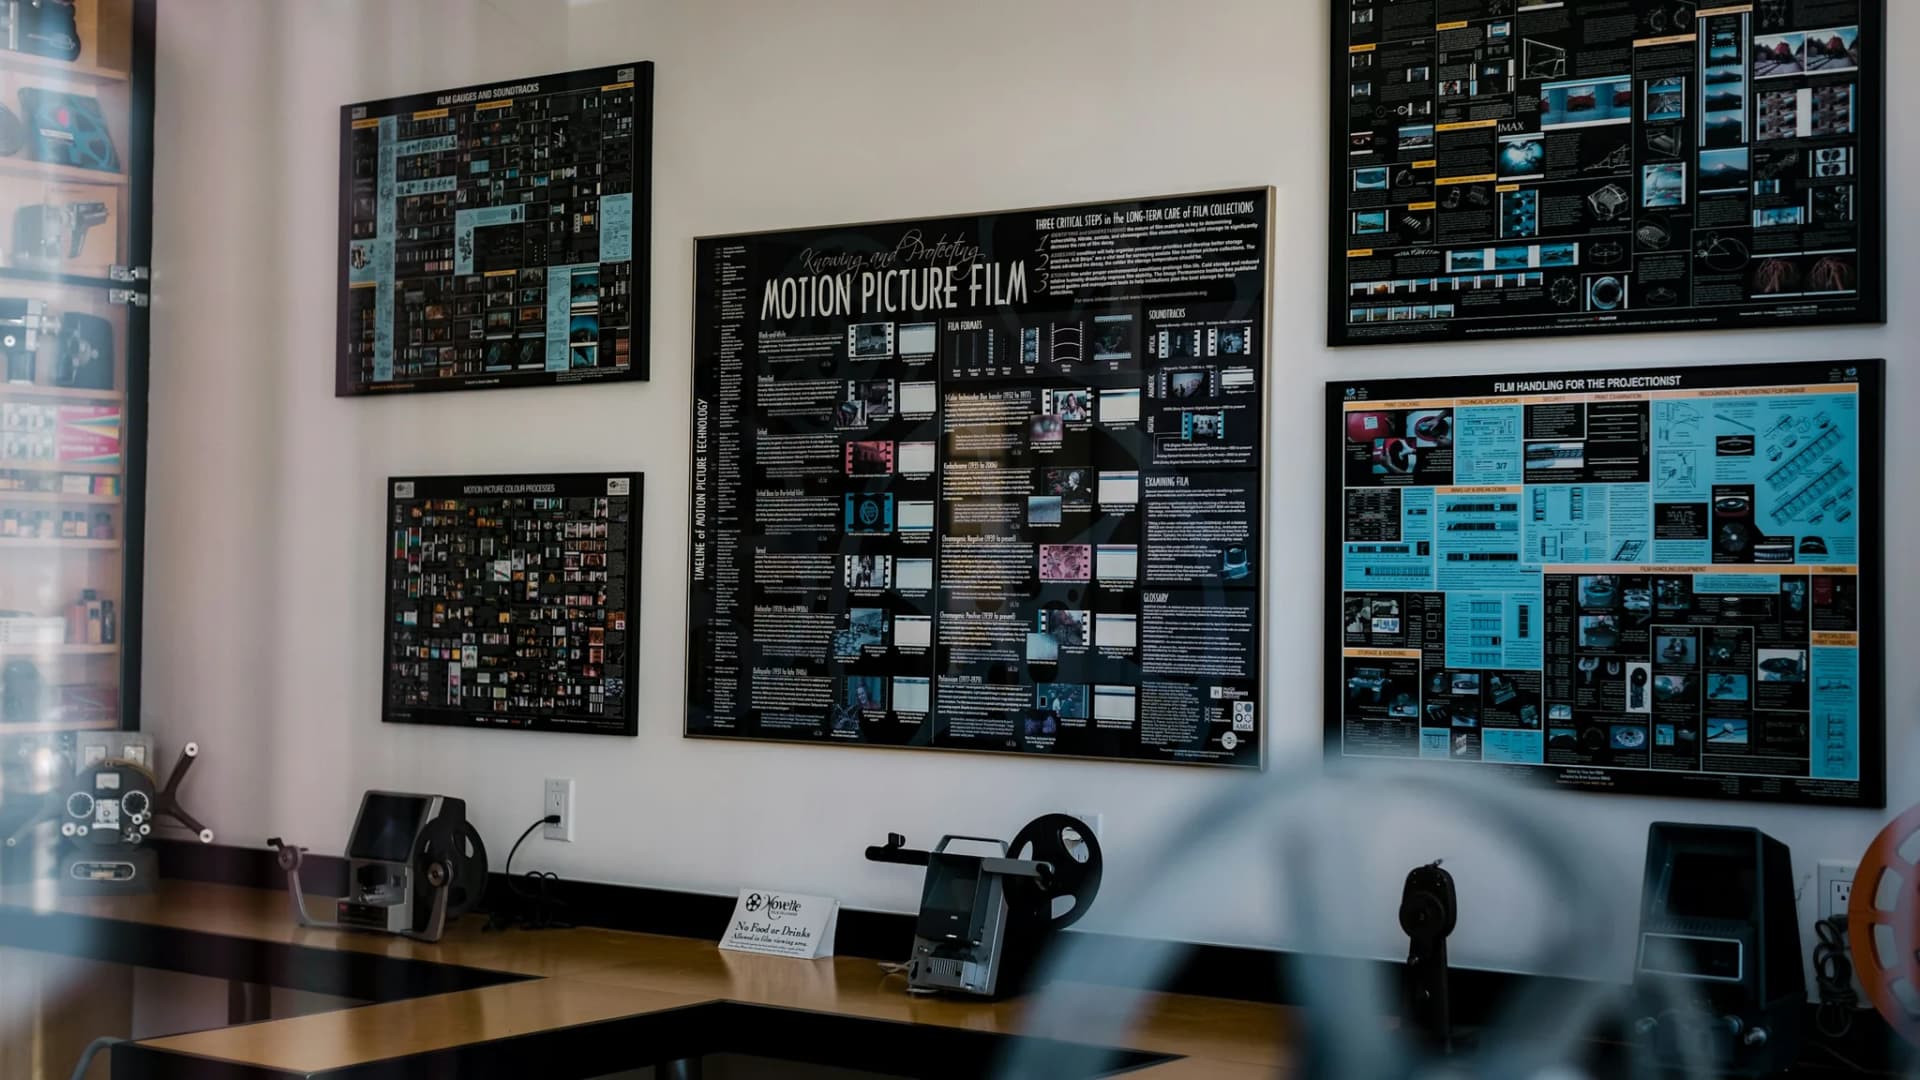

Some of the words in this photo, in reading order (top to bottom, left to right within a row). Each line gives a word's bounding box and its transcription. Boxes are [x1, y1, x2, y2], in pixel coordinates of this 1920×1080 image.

[437, 96, 452, 105] FILM
[452, 92, 477, 104] GAUGES
[478, 90, 492, 100] AND
[493, 83, 539, 98] SOUNDTRACKS
[1498, 121, 1524, 132] IMAX
[1036, 216, 1054, 229] THREE
[1056, 214, 1082, 227] CRITICAL
[1084, 213, 1102, 225] STEPS
[1104, 213, 1110, 224] in
[1113, 211, 1124, 223] the
[1126, 208, 1162, 222] LONG-TERM
[1164, 207, 1180, 219] CARE
[1192, 205, 1208, 217] FILM
[1210, 201, 1254, 216] COLLECTIONS
[802, 248, 869, 284] Knowing
[869, 248, 899, 270] and
[896, 228, 986, 281] Protecting
[1034, 254, 1048, 271] 2
[761, 273, 850, 321] MOTION
[862, 265, 958, 314] PICTURE
[969, 259, 1028, 307] FILM
[1033, 272, 1048, 293] 3
[1148, 308, 1186, 320] SOUNDTRACKS
[948, 322, 959, 331] FILM
[960, 320, 982, 330] FORMATS
[1494, 382, 1515, 393] FILM
[1516, 380, 1564, 392] HANDLING
[1566, 379, 1584, 390] FOR
[1587, 378, 1605, 389] THE
[1608, 376, 1681, 388] PROJECTIONIST
[696, 398, 708, 453] TECHNOLOGY
[696, 456, 707, 491] PICTURE
[1496, 462, 1508, 470] 3/7
[464, 484, 482, 494] MOTION
[484, 484, 504, 494] PICTURE
[504, 484, 525, 493] COLOUR
[526, 483, 556, 492] PROCESSES
[1145, 476, 1175, 487] EXAMINING
[1176, 476, 1190, 486] FILM
[695, 493, 706, 526] MOTION
[695, 529, 705, 539] of
[694, 542, 705, 581] TIMELINE
[1143, 592, 1169, 603] GLOSSARY
[736, 921, 749, 932] No
[750, 922, 770, 933] Food
[782, 926, 810, 938] Drinks
